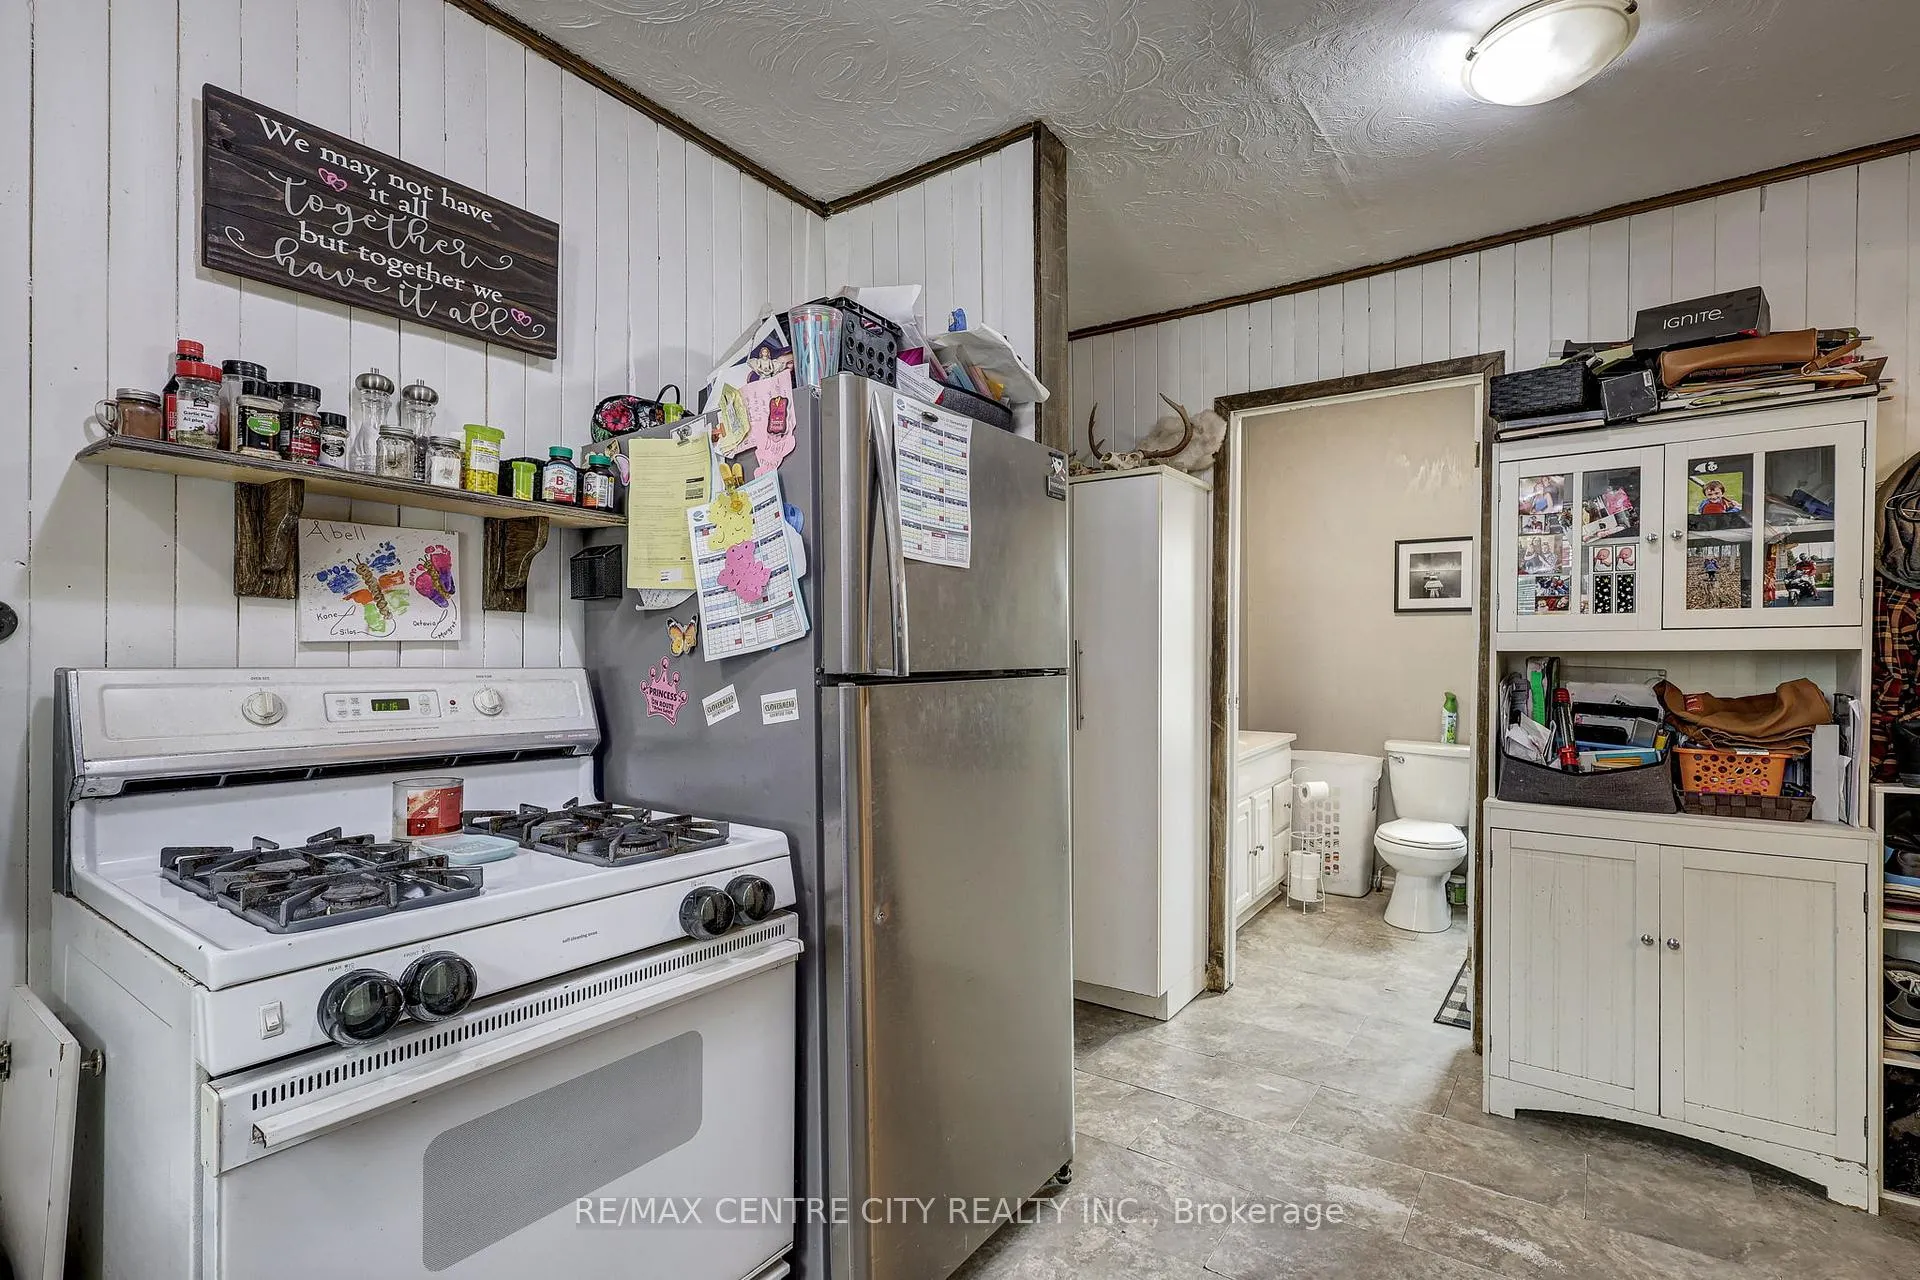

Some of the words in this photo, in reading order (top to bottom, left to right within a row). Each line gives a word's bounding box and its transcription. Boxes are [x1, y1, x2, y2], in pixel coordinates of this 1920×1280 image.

[255, 113, 309, 153] We
[320, 147, 379, 182] may
[388, 173, 433, 201] not
[441, 187, 493, 223] have
[268, 171, 513, 270] together
[369, 183, 390, 205] it
[399, 195, 428, 219] all
[224, 226, 390, 293] have
[399, 280, 437, 318] it
[449, 301, 545, 340] all
[299, 221, 349, 255] but
[359, 246, 465, 292] together
[473, 283, 503, 303] we
[306, 520, 366, 543] Abell
[649, 687, 677, 701] PRINCESS
[659, 701, 674, 710] ROUTE
